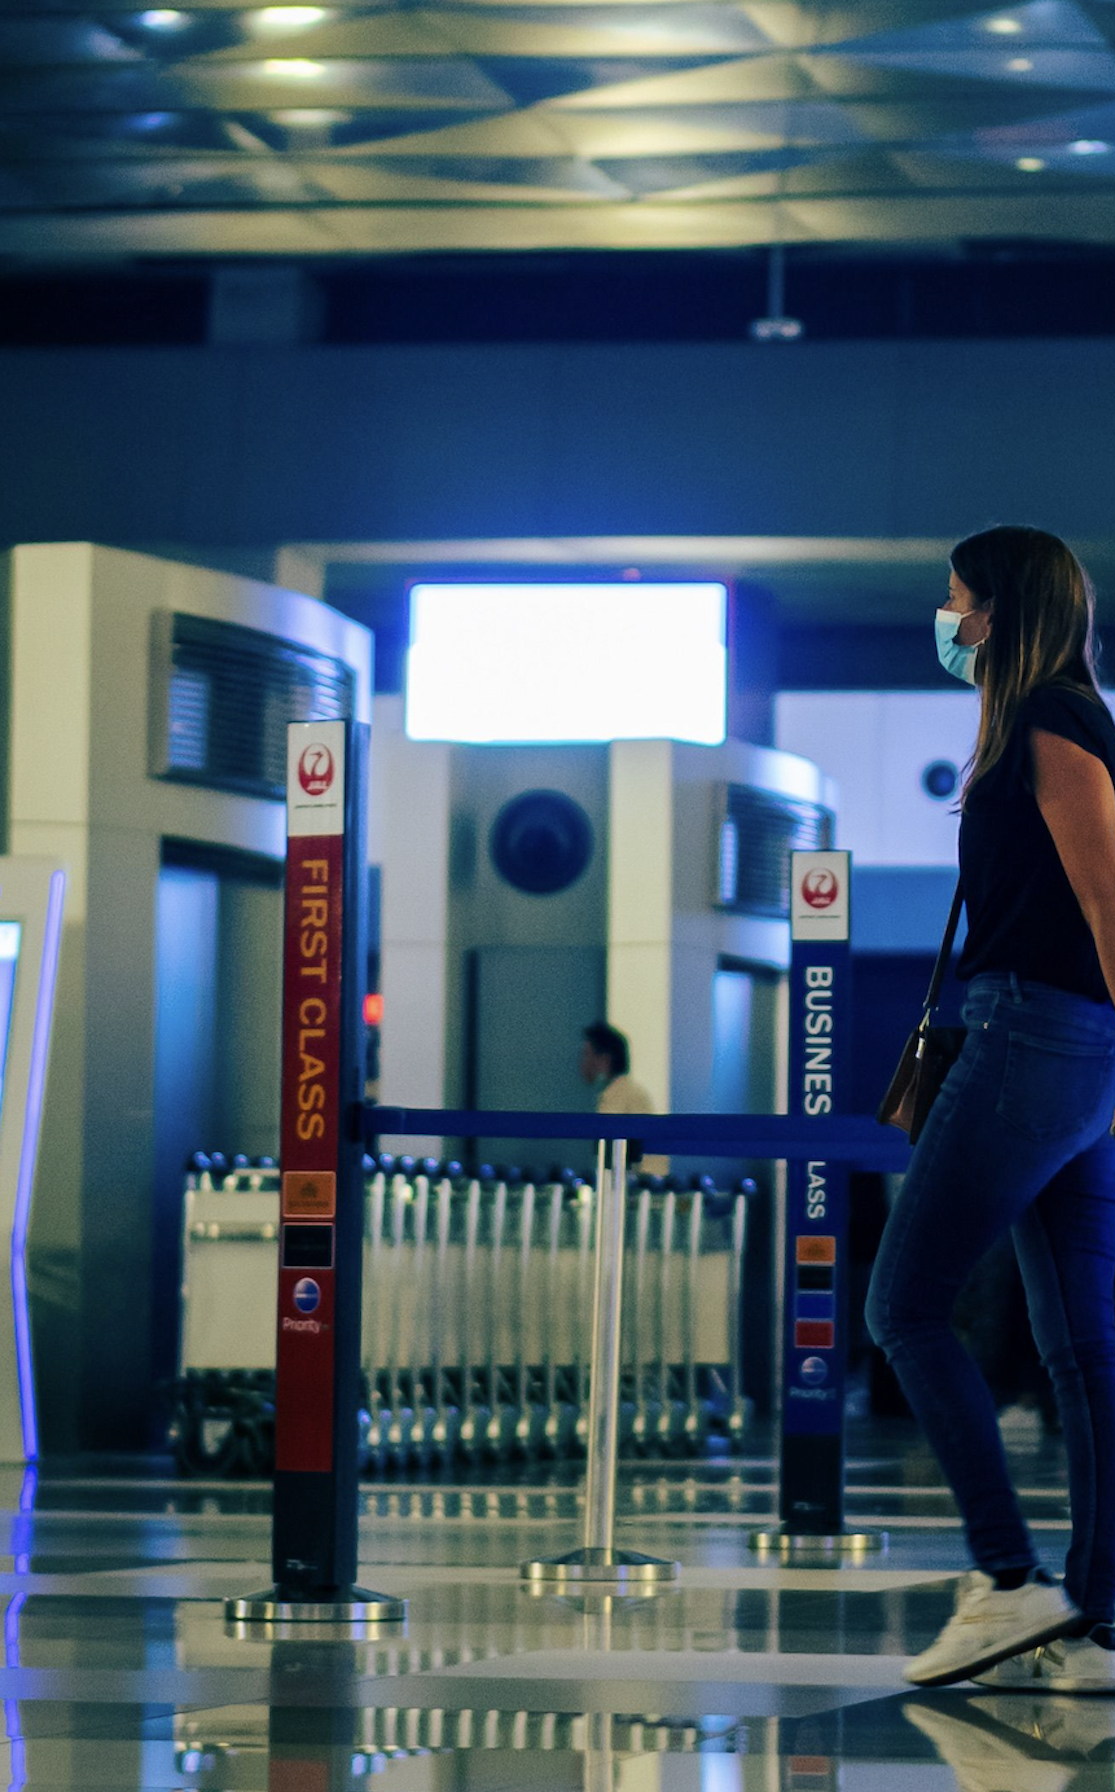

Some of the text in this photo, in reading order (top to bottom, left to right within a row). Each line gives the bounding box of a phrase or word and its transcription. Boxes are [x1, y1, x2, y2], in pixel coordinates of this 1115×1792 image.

[296, 859, 328, 1140] FIRST CLASS
[804, 966, 833, 1220] BUSINES LASS
[282, 1316, 322, 1334] Priority
